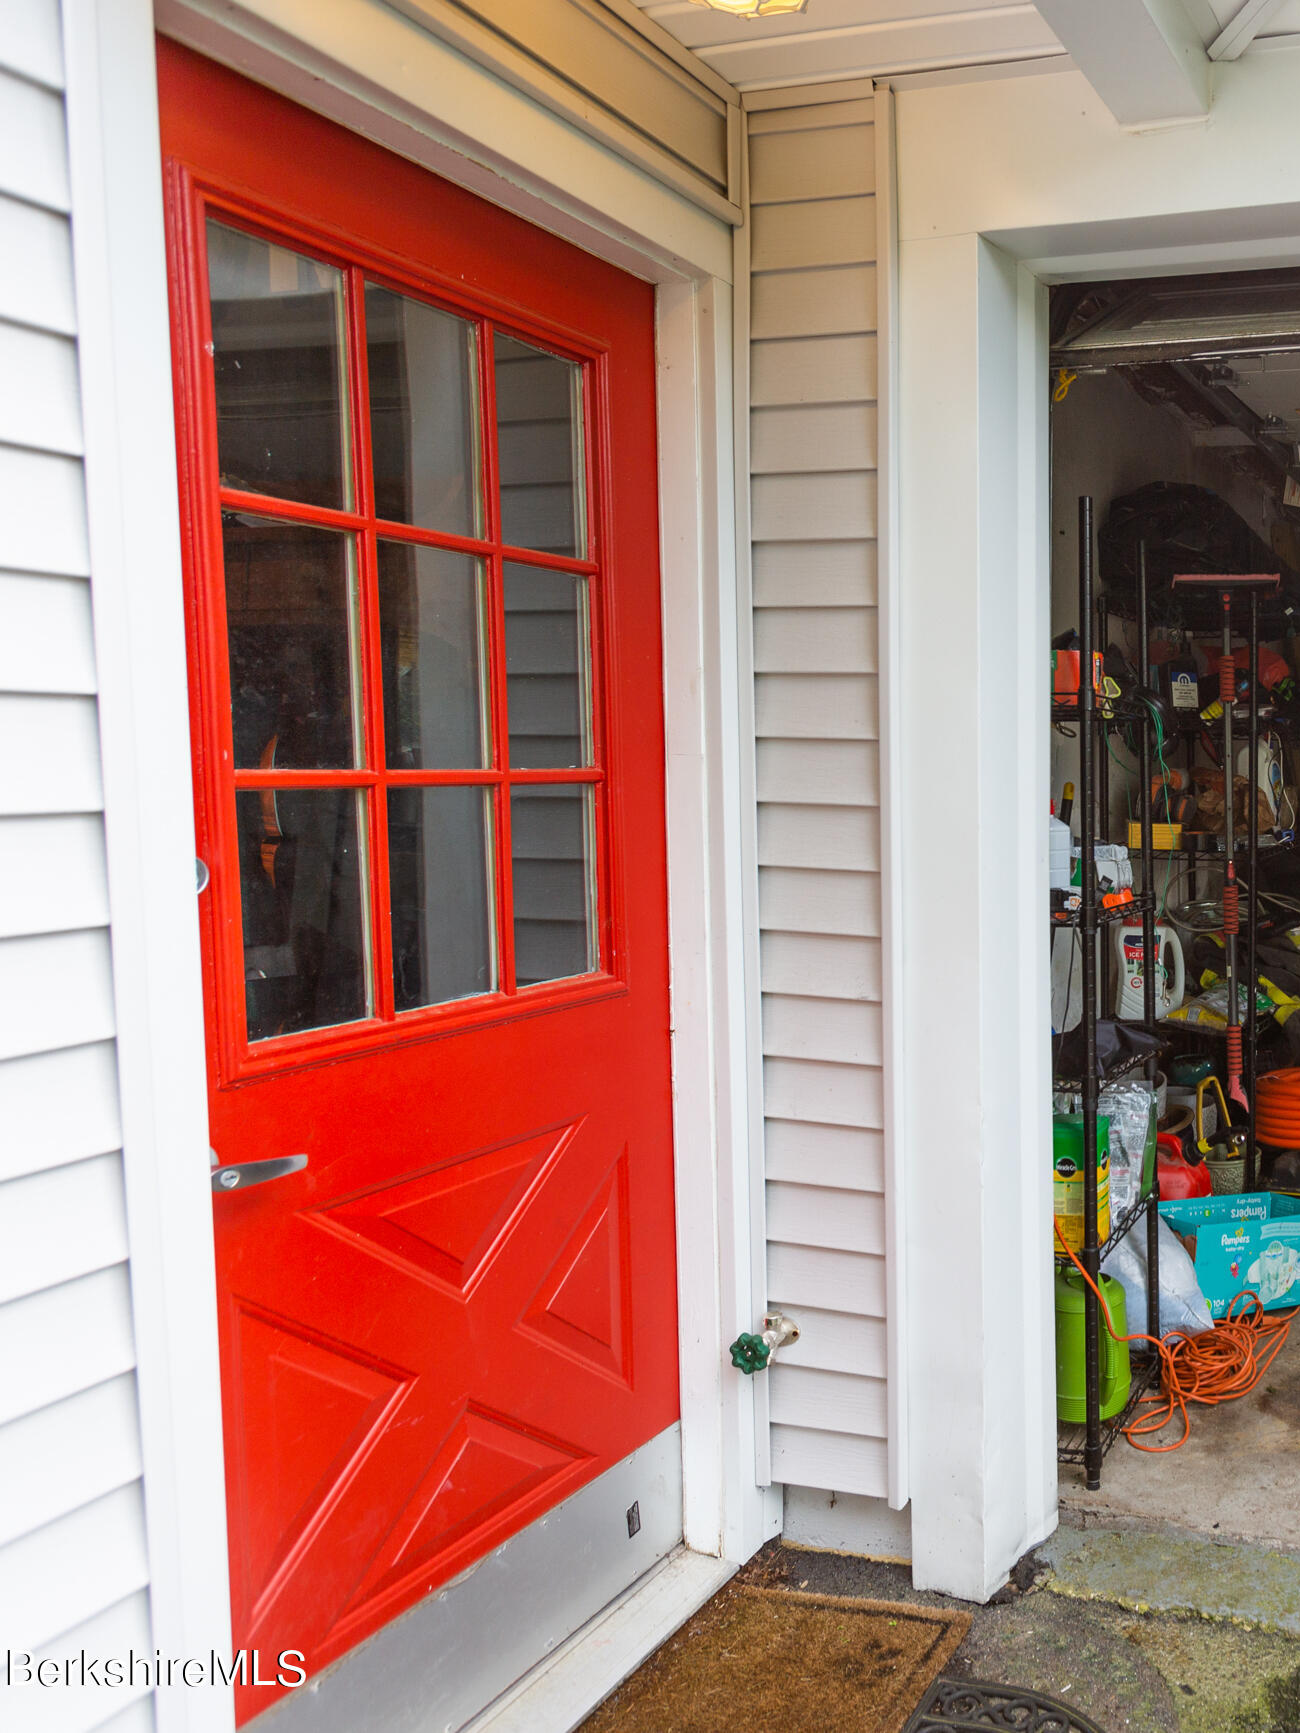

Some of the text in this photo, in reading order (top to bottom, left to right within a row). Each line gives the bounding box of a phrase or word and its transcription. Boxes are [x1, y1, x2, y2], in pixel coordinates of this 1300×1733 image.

[1231, 1205, 1267, 1220] Pampers
[1221, 1234, 1250, 1246] Pampers
[1213, 1299, 1225, 1307] 104
